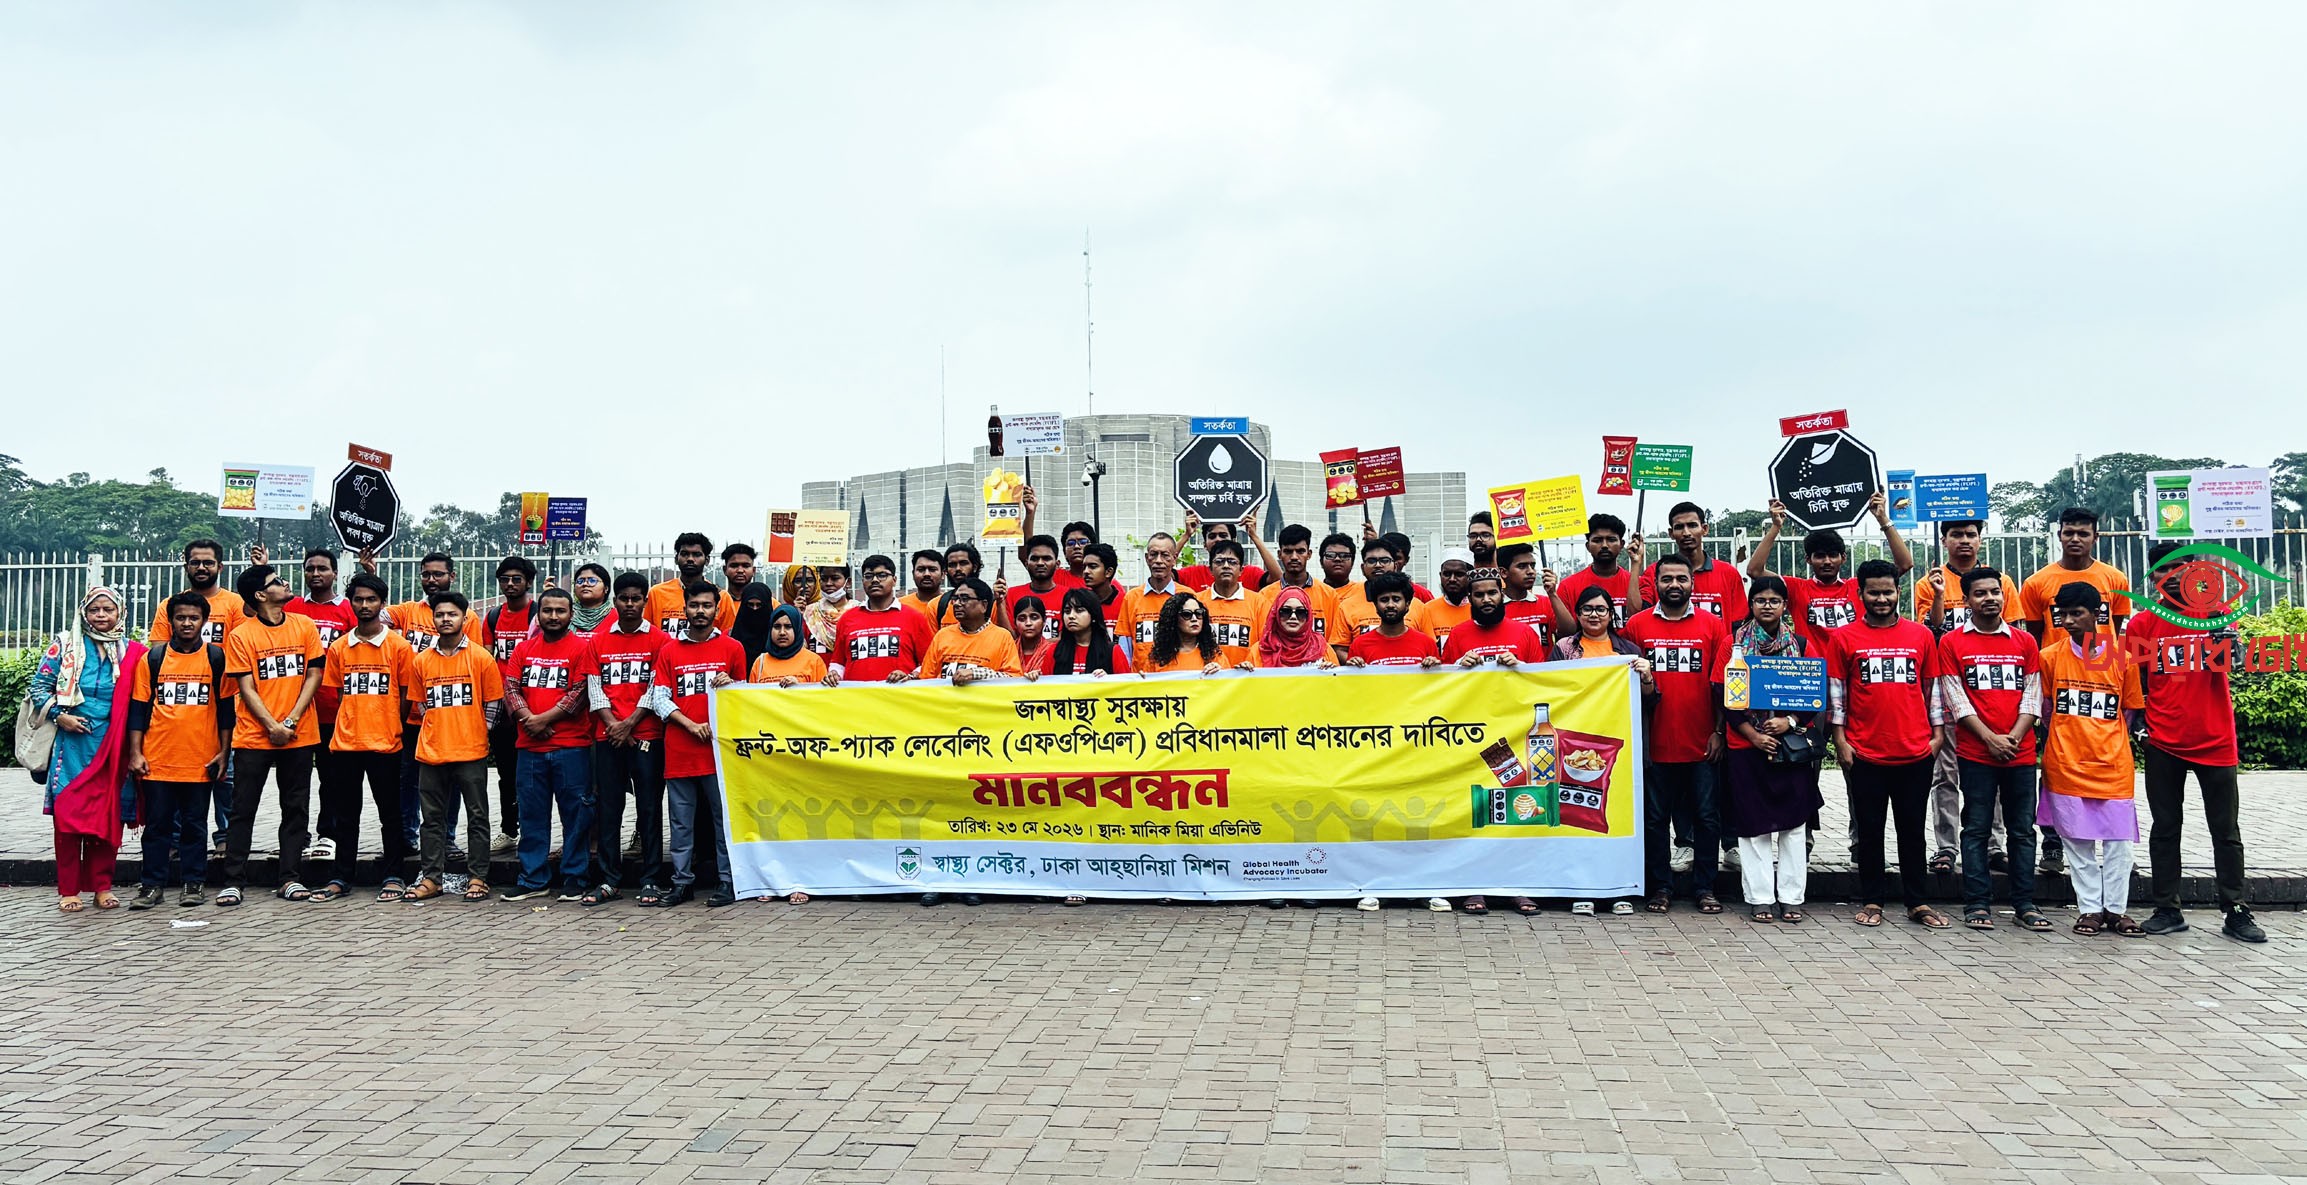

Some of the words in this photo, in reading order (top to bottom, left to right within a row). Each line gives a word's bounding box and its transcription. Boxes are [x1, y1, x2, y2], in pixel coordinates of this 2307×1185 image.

[1203, 419, 1236, 431] সতর্কতা
[1795, 414, 1833, 430] সতর্কতা
[357, 450, 382, 465] সতর্কতা
[1188, 478, 1224, 490] অতিরিক্ত
[1226, 480, 1252, 490] মাত্রায়
[1789, 485, 1832, 500] অতিরিক্ত
[1833, 481, 1863, 495] মাত্রায়
[1188, 493, 1216, 507] সম্পৃক্ত
[1218, 491, 1234, 503] চর্বি
[1235, 493, 1252, 505] যুক্ত
[1808, 499, 1830, 513] চিনি
[1830, 498, 1850, 512] যুক্ত
[339, 510, 366, 526] অতিরিক্ত
[366, 518, 386, 533] মাত্রায়
[346, 526, 361, 539] লবণ
[362, 531, 374, 544] যুক্ত
[1013, 697, 1099, 726] জনস্বাস্থ্য
[1105, 694, 1189, 726] সুরক্ষায়
[732, 730, 897, 760] ফ্রন্ট-অফ-প্যাক
[904, 726, 993, 758] লেবেলিং
[1003, 724, 1146, 762] (এফওপিএল)
[1156, 722, 1289, 754] প্রবিধানমালা
[1296, 723, 1394, 751] প্রণয়নের
[1400, 716, 1487, 747] দাবিতে
[968, 768, 1230, 811] মানববন্ধন
[948, 816, 991, 834] তারিখ:
[996, 822, 1017, 834] ২৩
[1022, 820, 1038, 834] মে
[1043, 822, 1083, 837] ২০২৬
[1097, 823, 1126, 840] স্থান:
[1130, 820, 1171, 838] মানিক
[1175, 820, 1204, 838] মিয়া
[1209, 819, 1262, 837] এভিনিউ
[931, 854, 971, 878] স্বাস্থ্য
[976, 850, 1035, 878] সেক্টর,
[1040, 856, 1082, 875] ঢাকা
[1086, 853, 1177, 880] আহ্ছানিয়া
[1181, 853, 1231, 877] মিশন
[1242, 860, 1271, 868] Global
[1272, 859, 1300, 867] Health
[1243, 868, 1285, 876] Advocacy
[1286, 867, 1328, 875] Incubator
